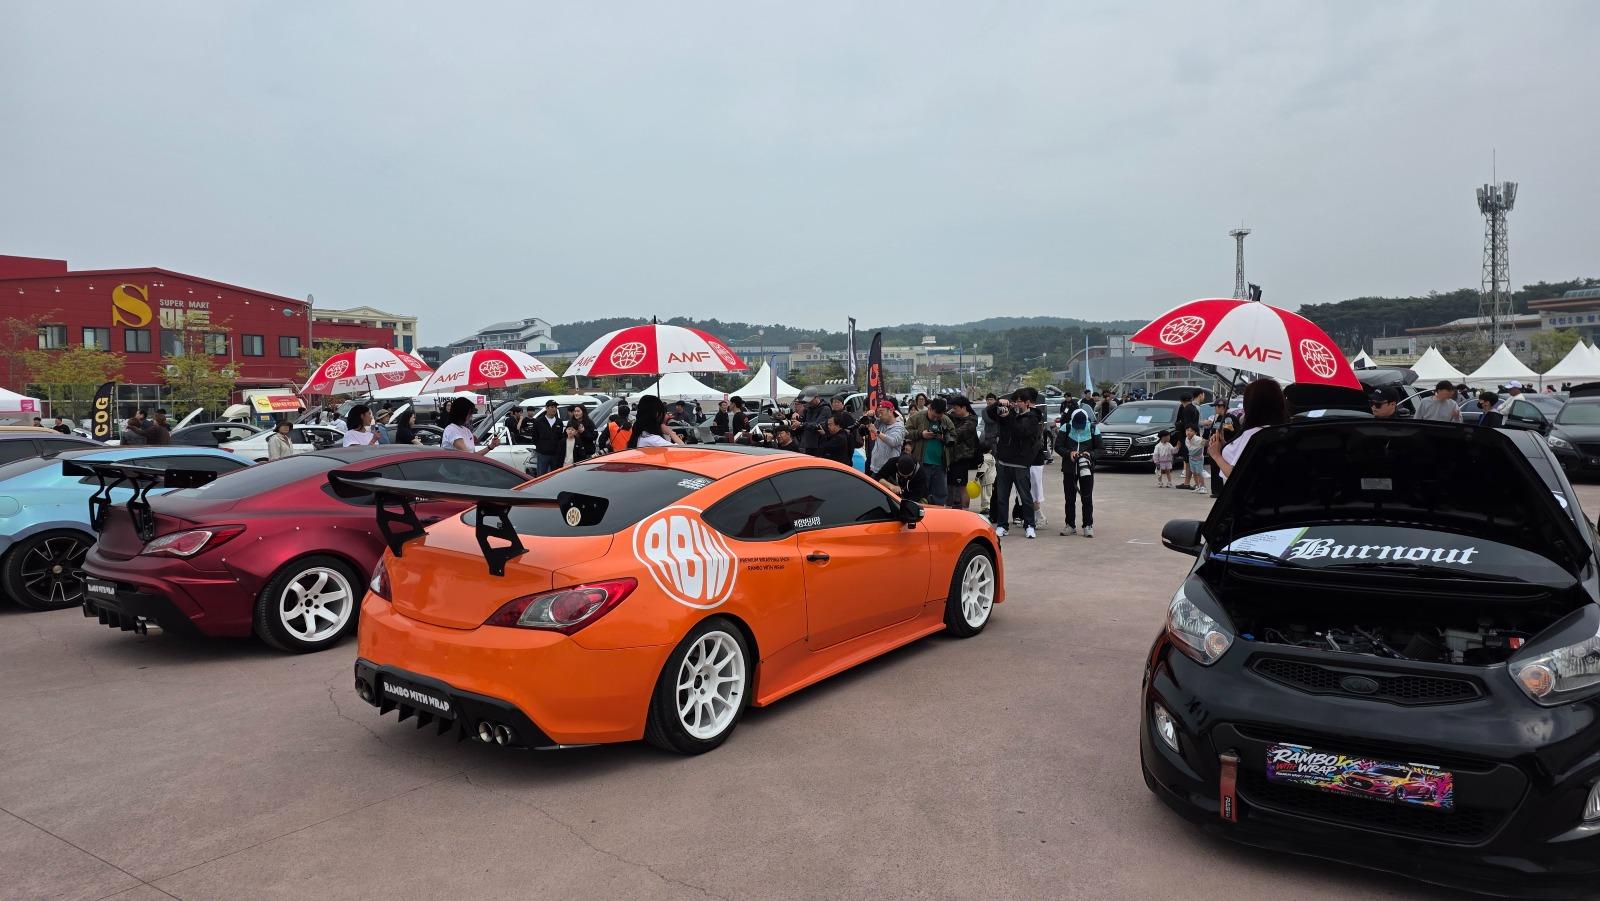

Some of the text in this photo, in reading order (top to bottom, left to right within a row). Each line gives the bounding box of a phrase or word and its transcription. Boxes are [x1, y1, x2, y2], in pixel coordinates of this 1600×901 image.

[112, 284, 153, 328] S
[160, 299, 210, 309] SUPER MART
[668, 351, 711, 364] AMF
[1214, 340, 1283, 363] AMF
[363, 360, 397, 370] AMF
[576, 355, 597, 368] AMF
[433, 370, 466, 385] AMF
[95, 397, 109, 437] COG
[644, 515, 730, 600] RBW
[1286, 537, 1479, 564] Burnout
[384, 681, 450, 712] RAMBO WITH WRAP
[1272, 749, 1338, 765] RAMBO
[1297, 763, 1337, 775] WRAP
